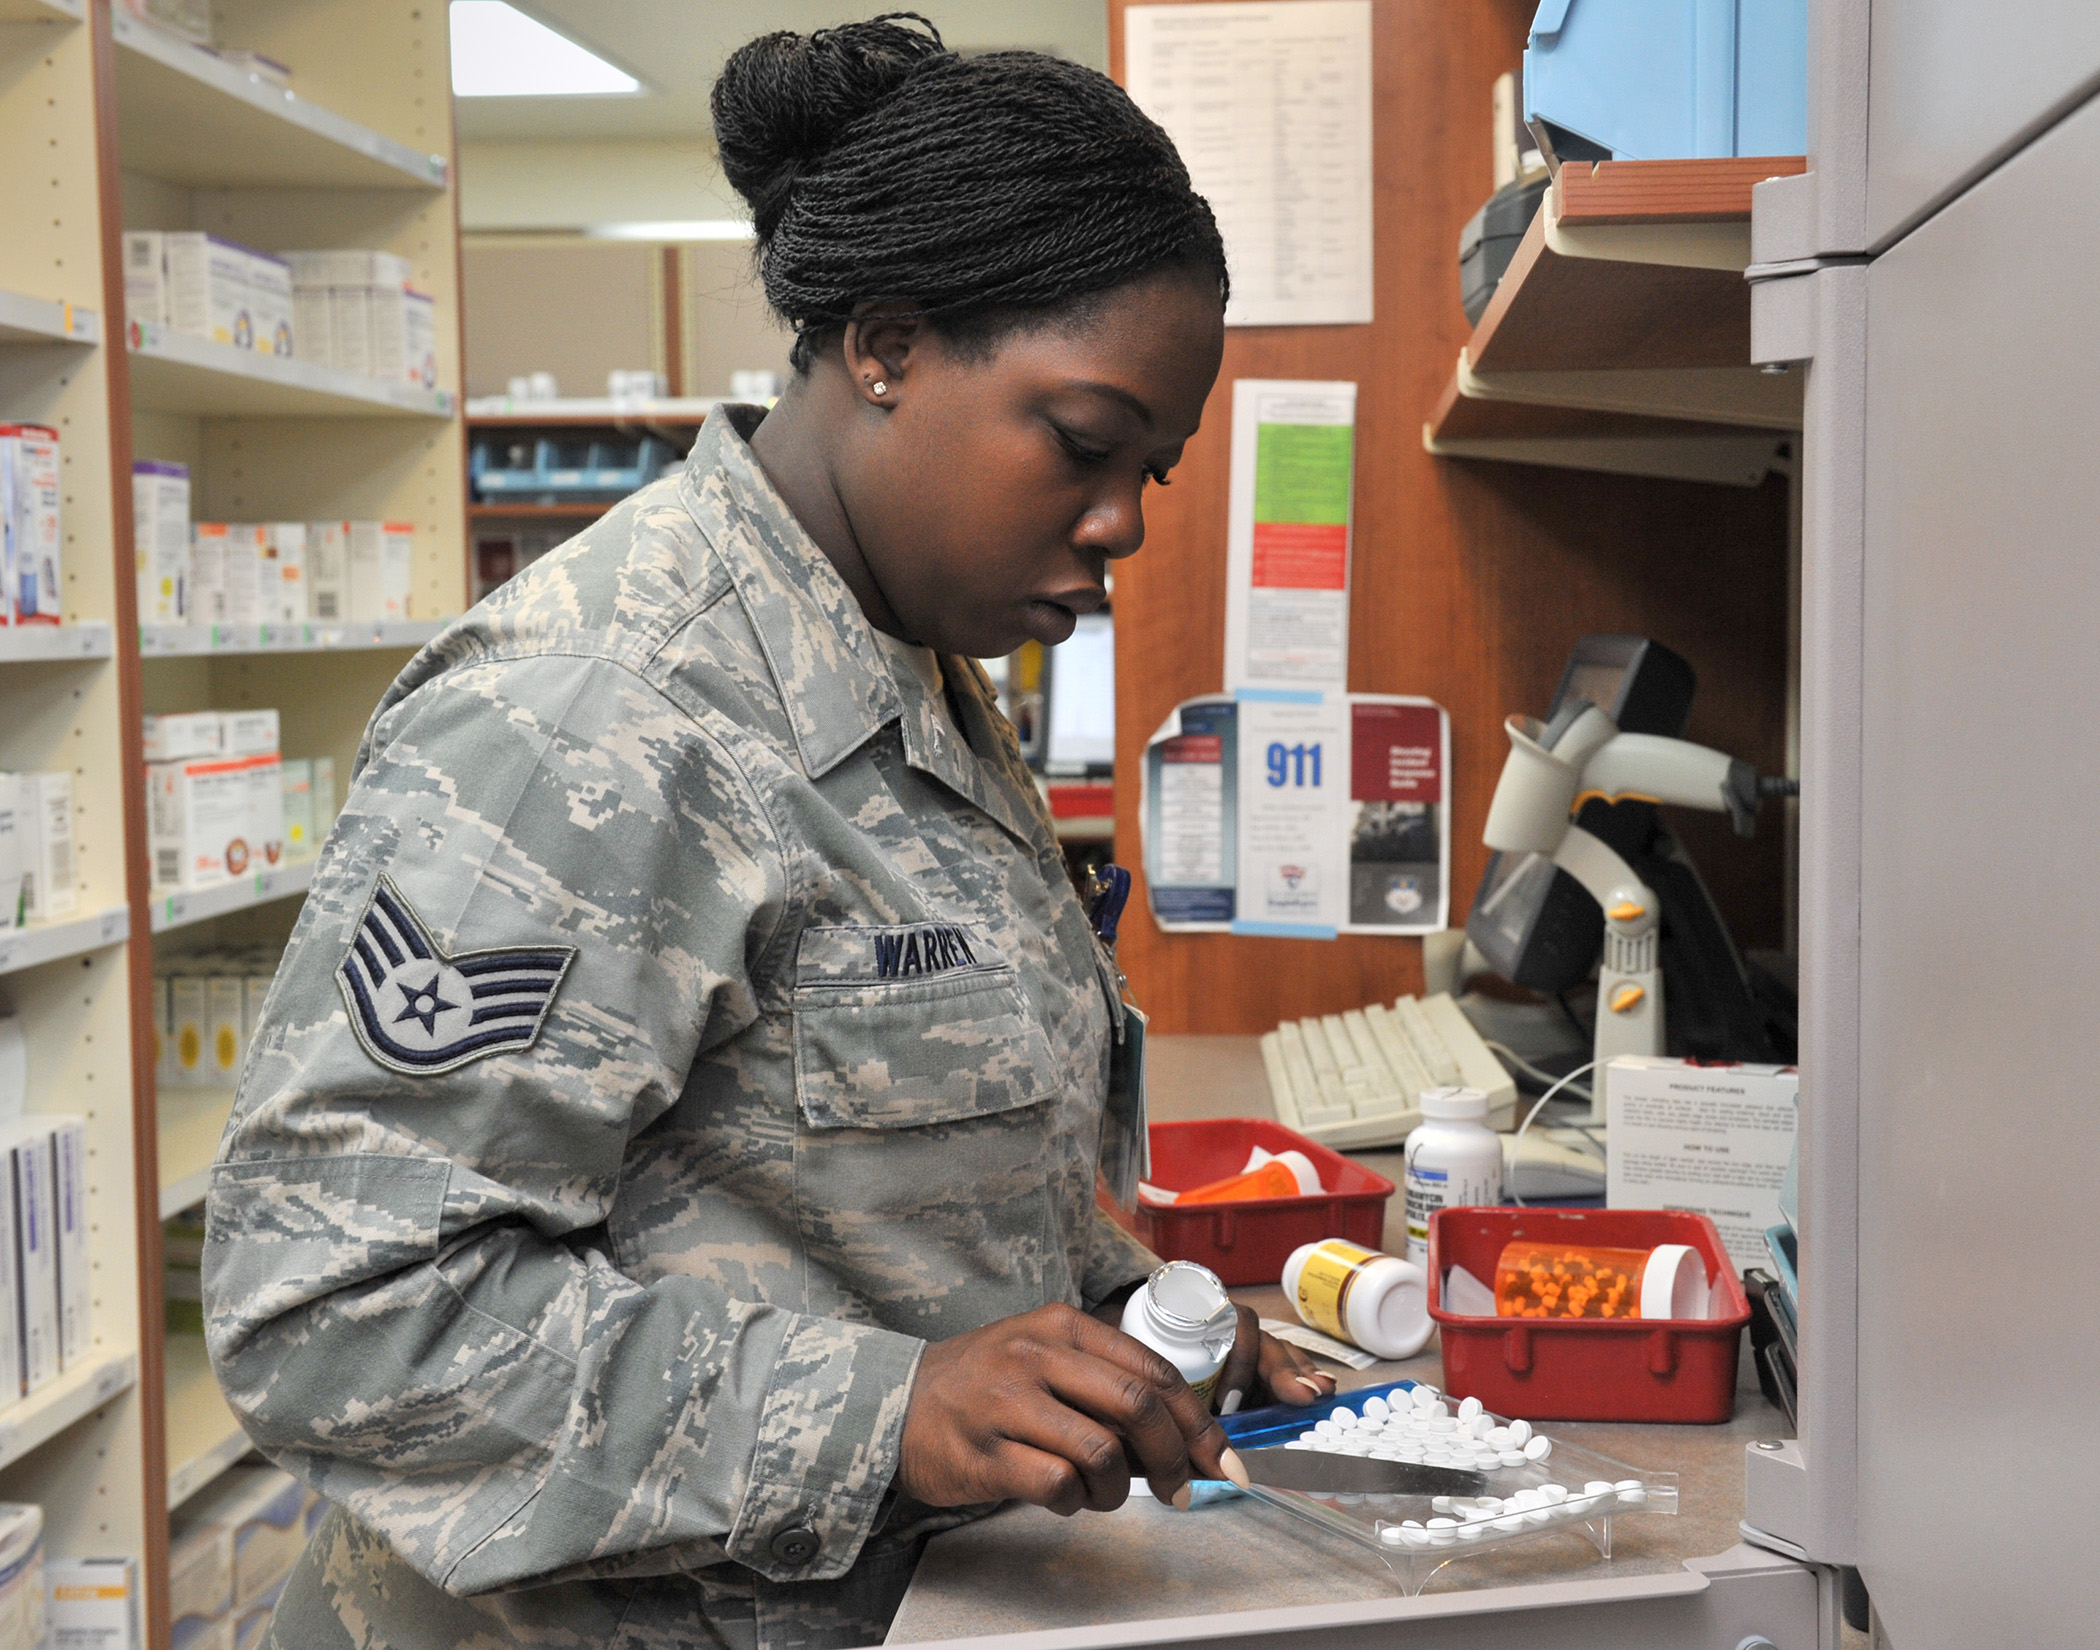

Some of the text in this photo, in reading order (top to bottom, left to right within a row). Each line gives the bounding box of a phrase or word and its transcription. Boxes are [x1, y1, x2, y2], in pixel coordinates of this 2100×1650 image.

[1266, 742, 1321, 788] 911
[873, 926, 979, 978] WARREN
[1669, 1083, 1746, 1095] PRODUCT FEATURES
[1683, 1143, 1730, 1154] HOW TO USE
